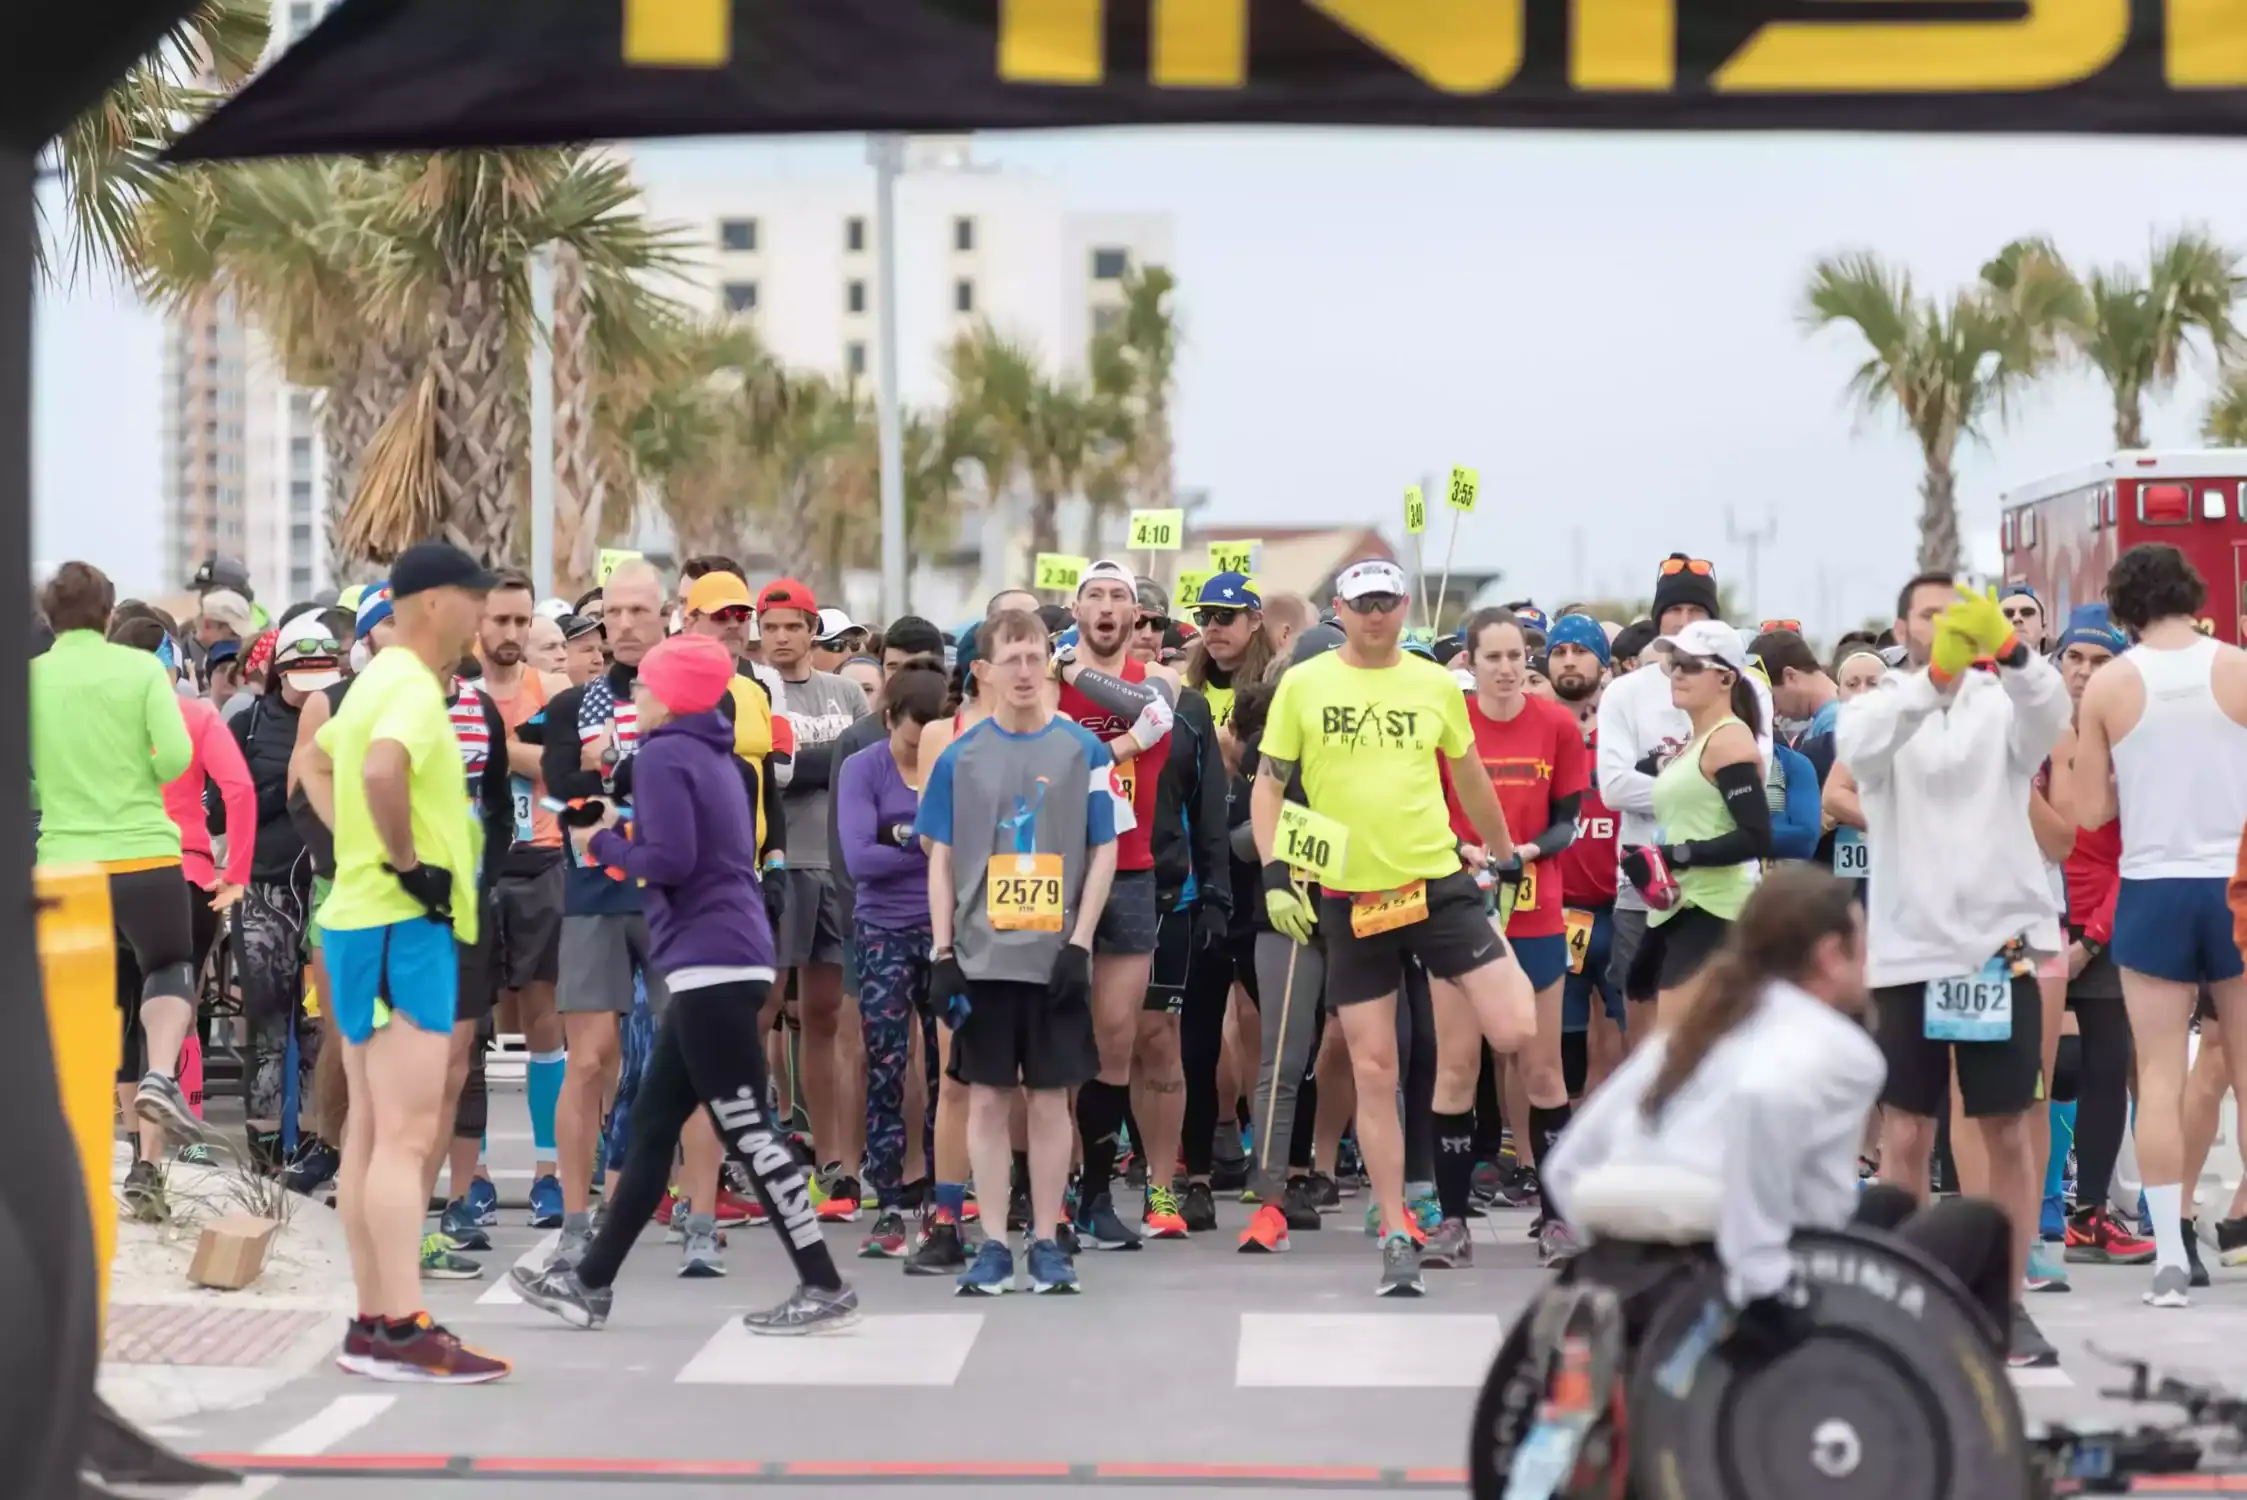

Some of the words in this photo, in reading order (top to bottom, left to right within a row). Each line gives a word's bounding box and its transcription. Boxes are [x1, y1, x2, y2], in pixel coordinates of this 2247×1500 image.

[1451, 480, 1474, 507] 3:55
[1137, 525, 1170, 544] 4:10
[1044, 567, 1078, 585] 2:30
[1217, 554, 1250, 573] 4:25
[1322, 702, 1418, 740] BEAST
[1322, 735, 1424, 750] PACING
[1287, 828, 1330, 869] 1:40
[1841, 845, 1868, 869] 30
[996, 879, 1059, 905] 2579
[1935, 981, 2008, 1012] 3062
[737, 1131, 793, 1177] DO
